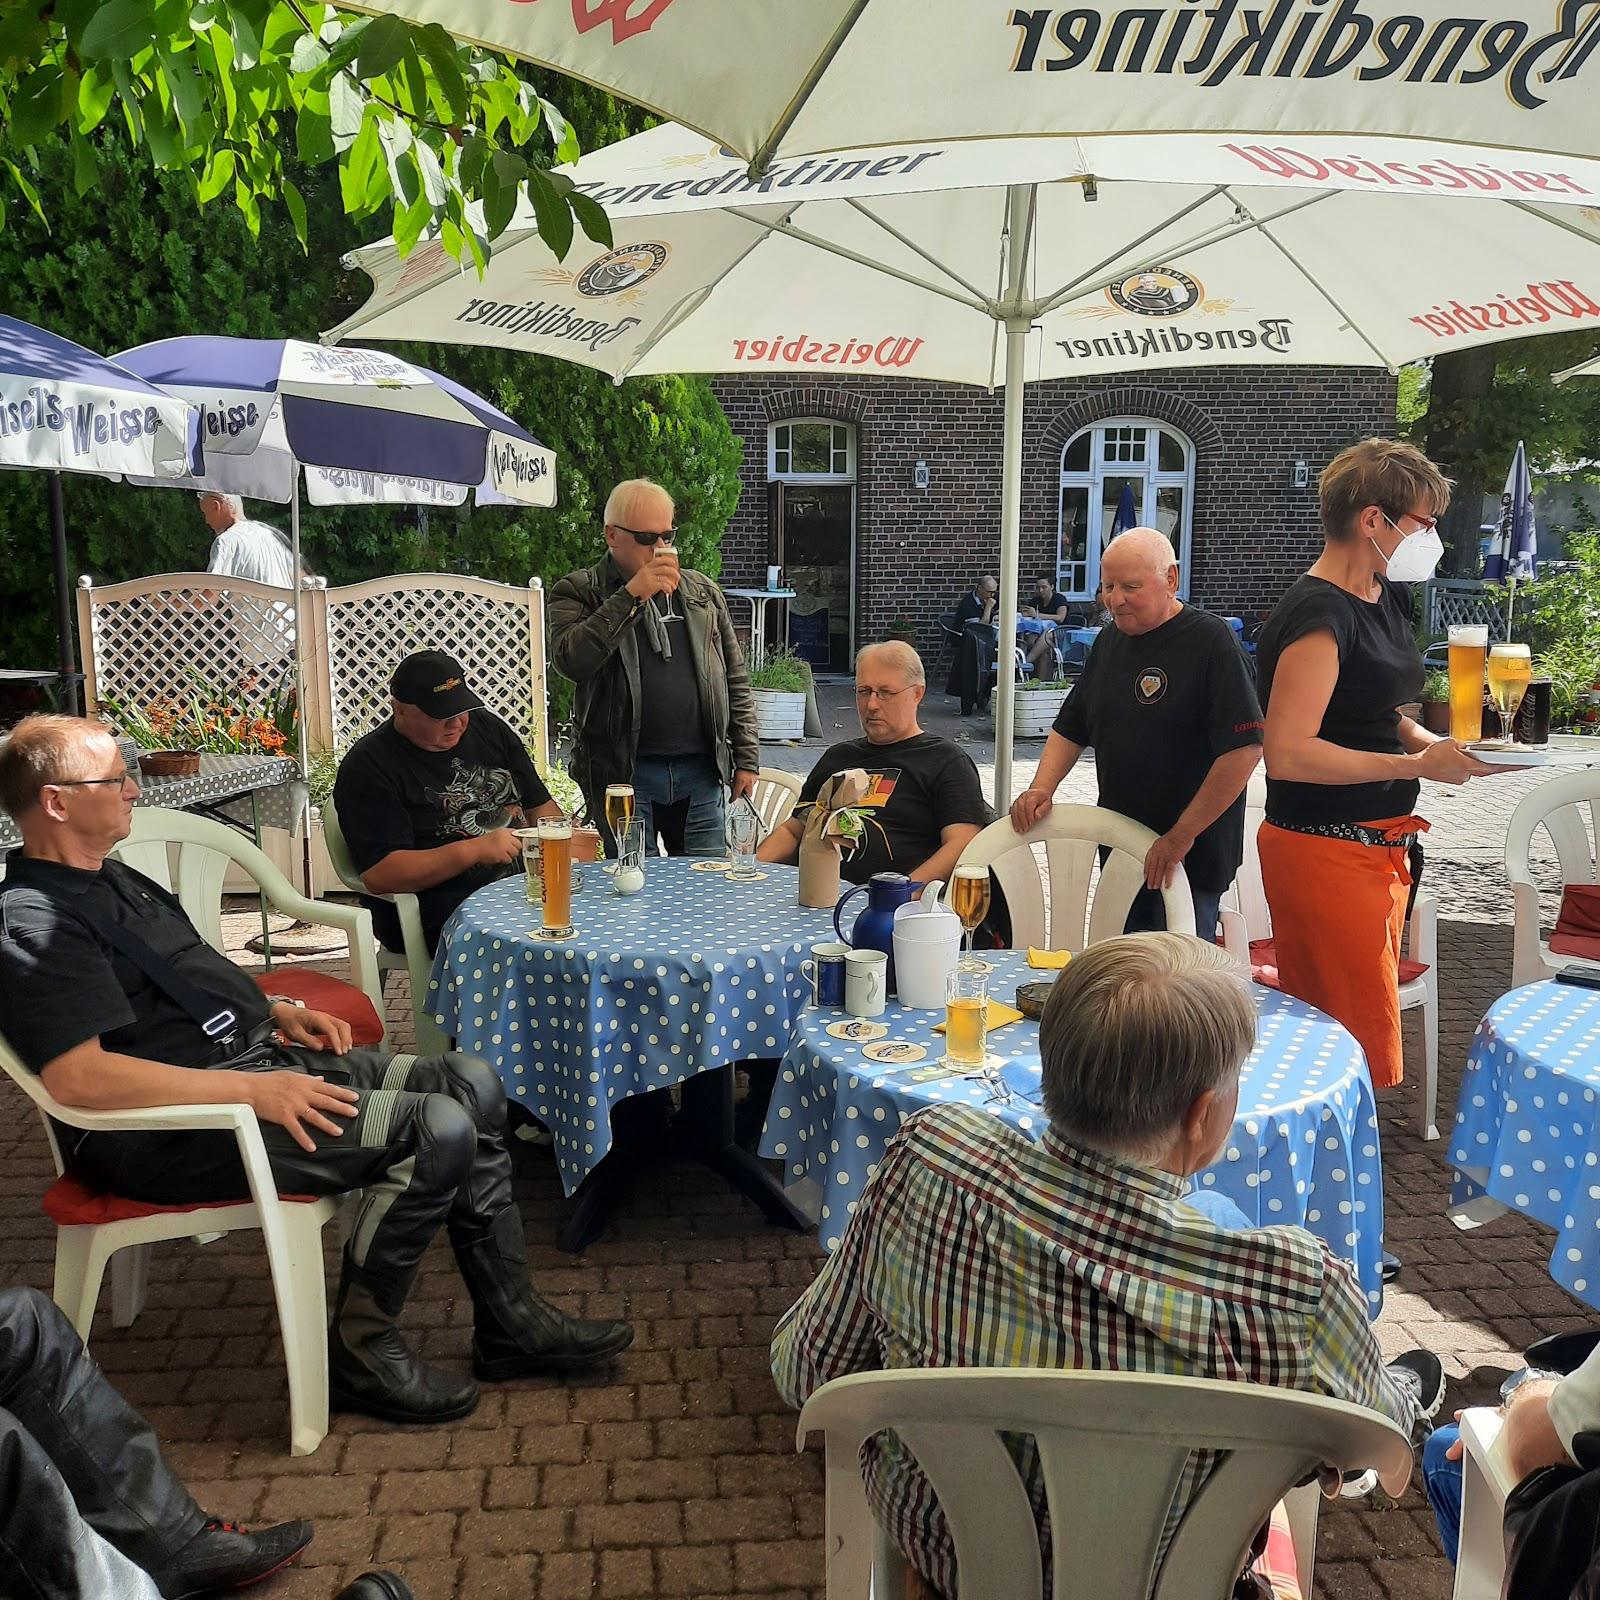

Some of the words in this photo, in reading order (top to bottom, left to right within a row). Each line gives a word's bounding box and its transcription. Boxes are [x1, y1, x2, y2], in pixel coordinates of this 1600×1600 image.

[1220, 143, 1592, 194] Weissbier
[64, 399, 163, 456] Weisse
[201, 399, 260, 445] eisse
